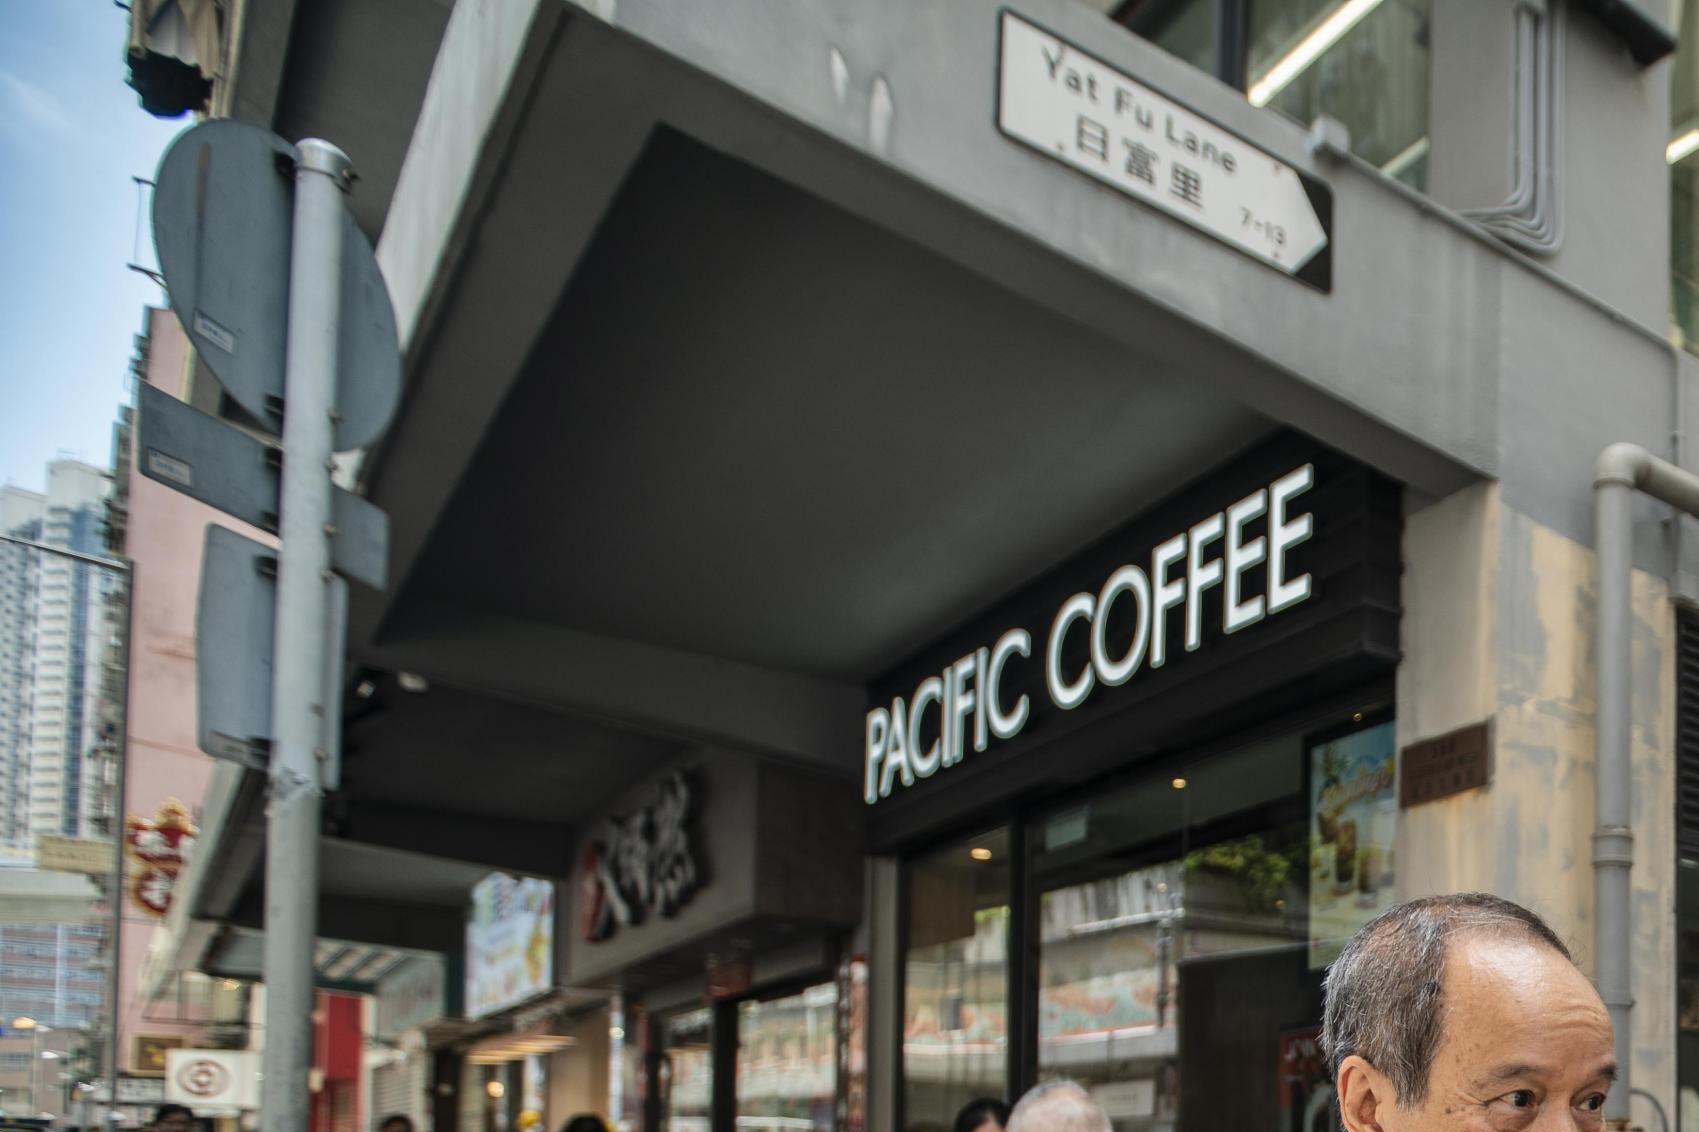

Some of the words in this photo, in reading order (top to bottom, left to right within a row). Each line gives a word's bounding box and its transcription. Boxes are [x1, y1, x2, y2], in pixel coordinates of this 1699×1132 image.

[1041, 43, 1099, 102] Yat
[1113, 86, 1154, 130] Fu
[1165, 115, 1238, 174] Lane
[1075, 114, 1204, 210] 日富里
[863, 627, 1032, 805] PACIFIC
[1046, 462, 1315, 710] COFFEE
